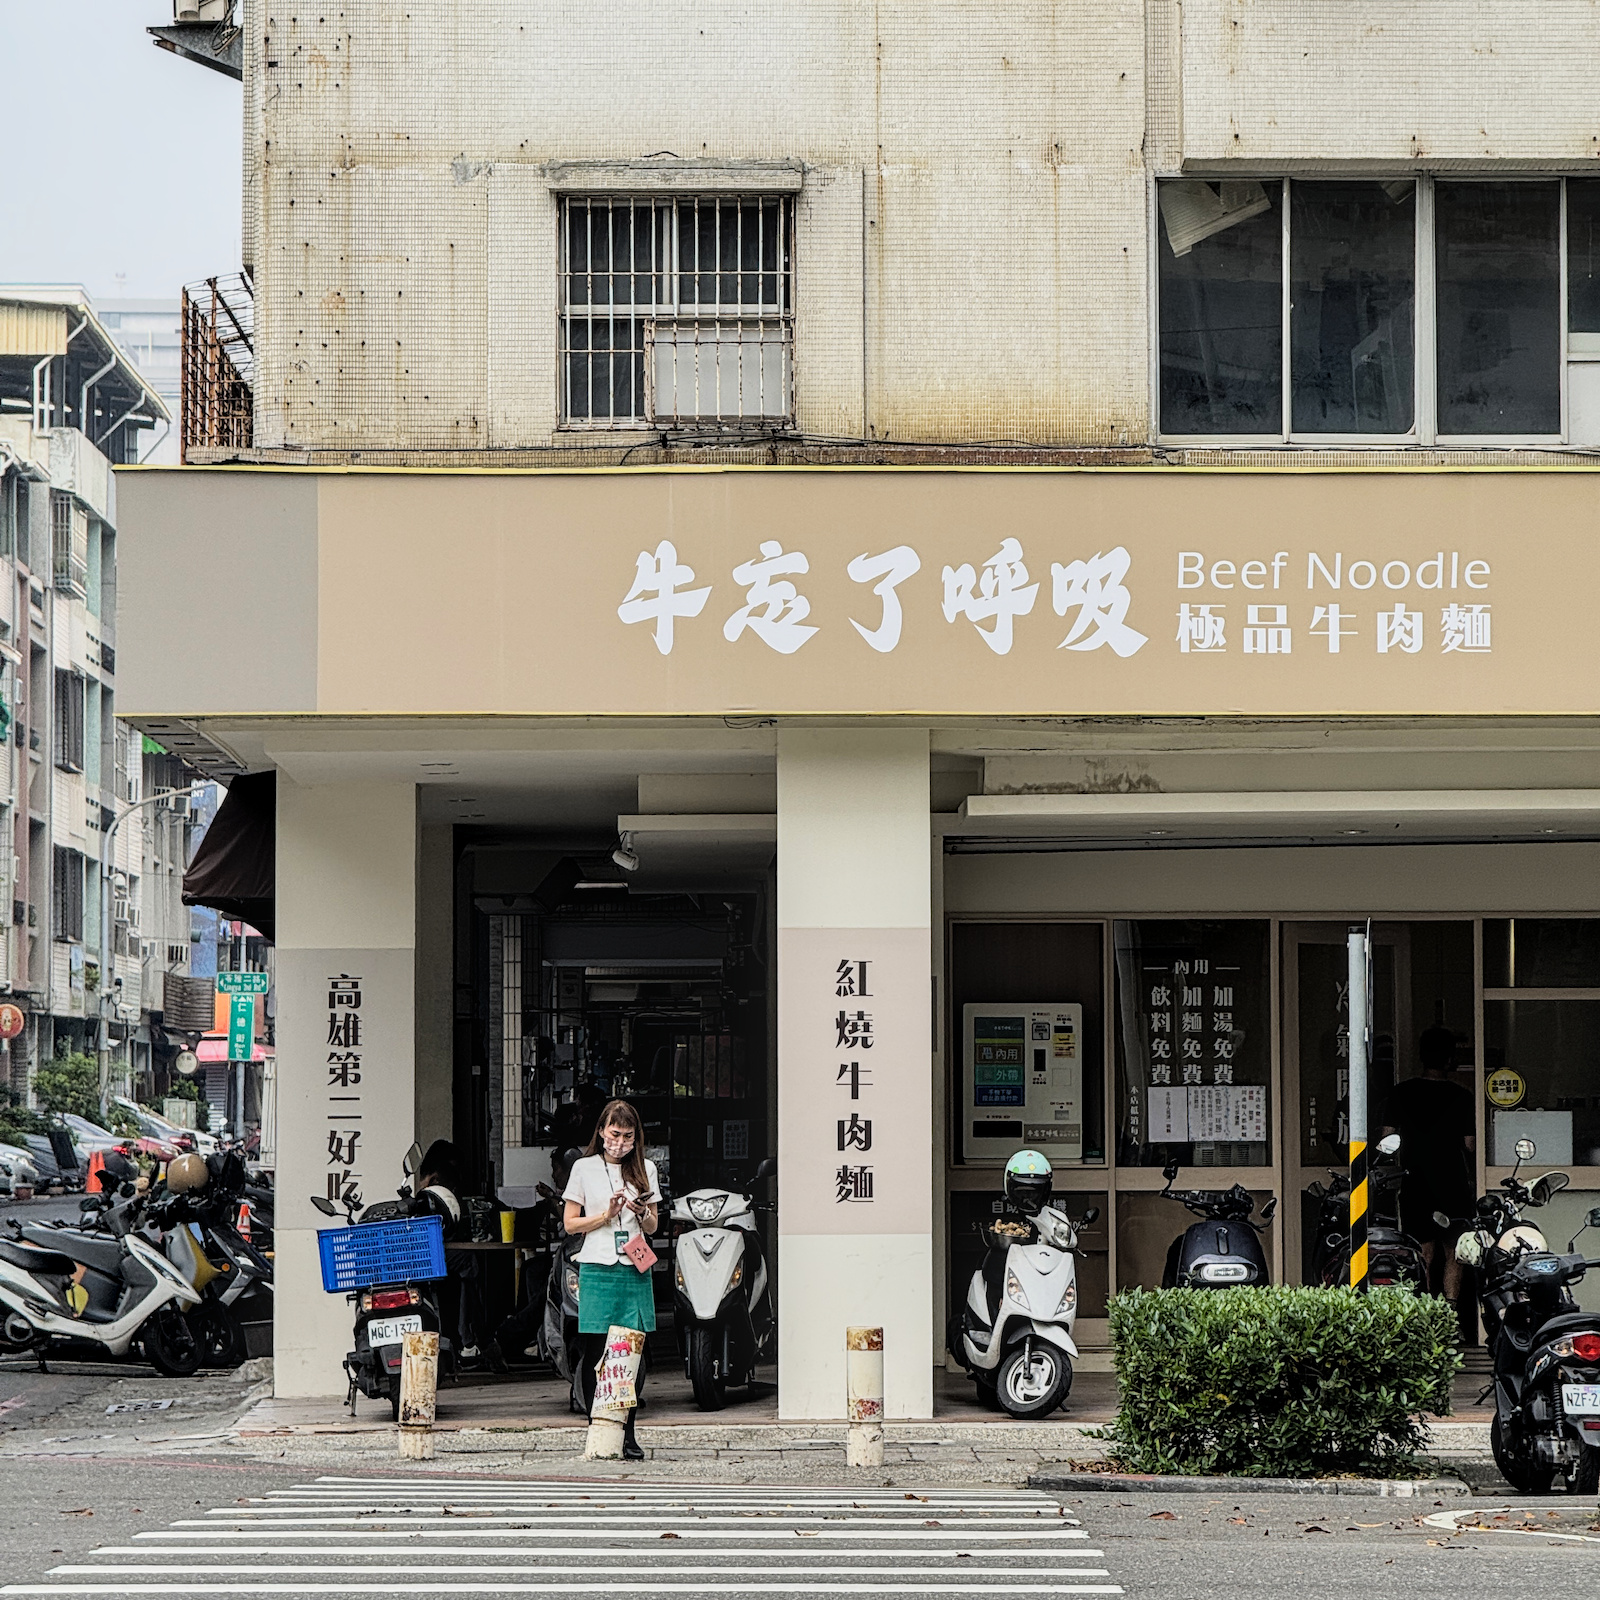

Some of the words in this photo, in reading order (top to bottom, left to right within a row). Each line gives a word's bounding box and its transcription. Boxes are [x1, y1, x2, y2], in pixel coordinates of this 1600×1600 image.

[617, 537, 1149, 658] 牛忘了呼吸
[1177, 551, 1289, 590] Beef
[1307, 551, 1491, 590] Noodle
[1175, 602, 1492, 654] 極品牛肉麵
[835, 959, 874, 1204] 紅燒牛肉麵
[1151, 986, 1171, 1085] 飲料免費
[1182, 986, 1203, 1085] 加麵免費
[1213, 986, 1234, 1085] 加湯免費
[326, 973, 363, 1201] 高雄第二好吃
